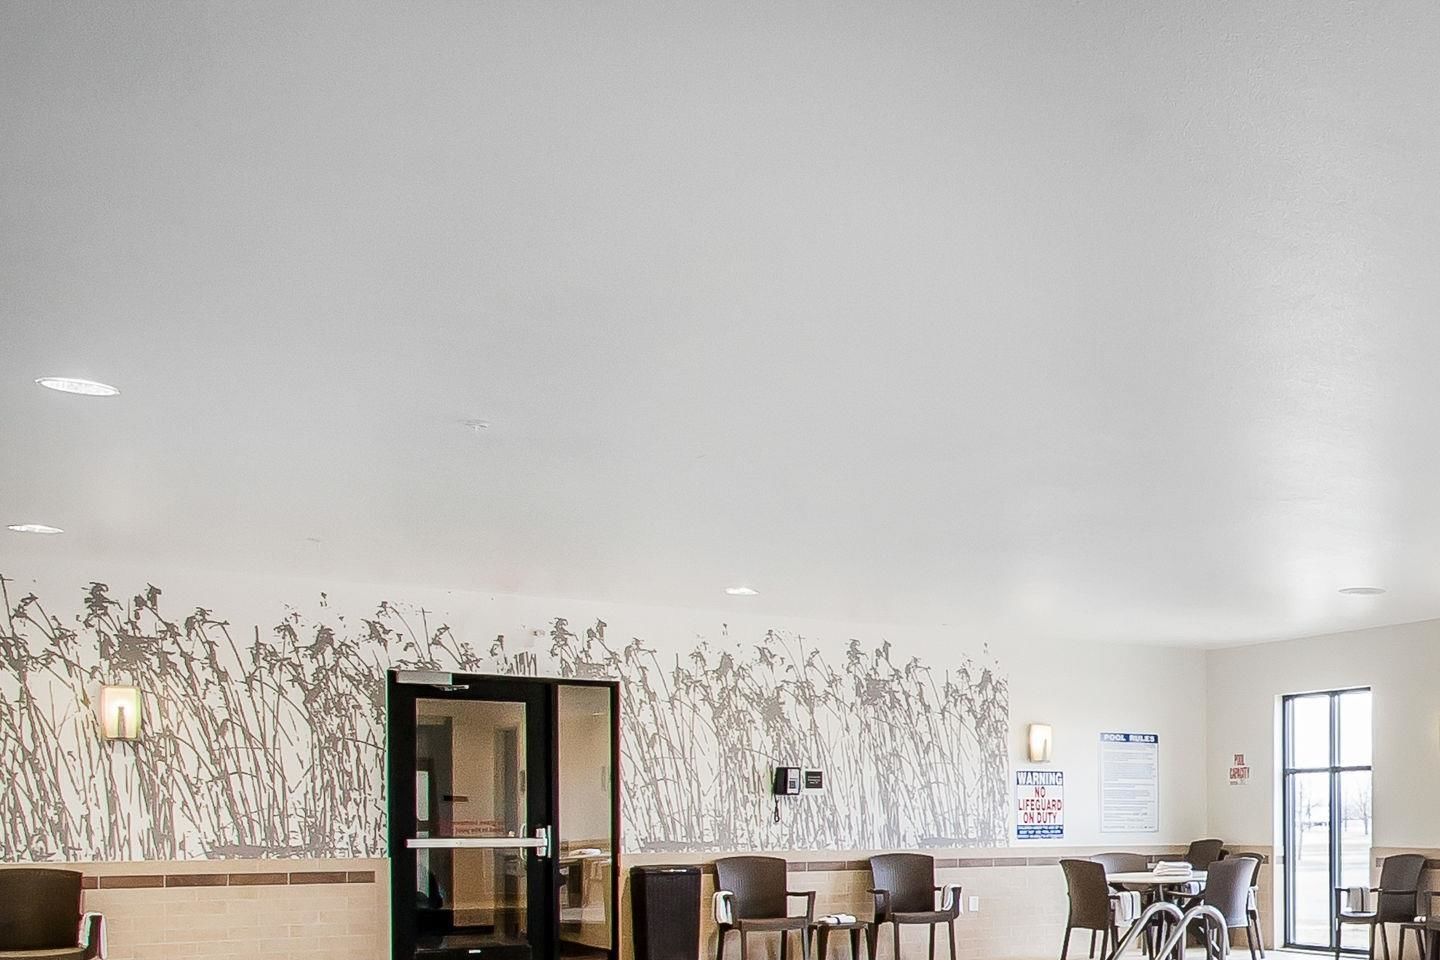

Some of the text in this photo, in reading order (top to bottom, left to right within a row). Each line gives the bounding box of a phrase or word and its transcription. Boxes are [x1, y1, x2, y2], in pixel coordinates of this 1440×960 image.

[1017, 772, 1063, 785] WARNING
[1034, 786, 1046, 798] NO
[1018, 799, 1062, 811] LIFEGUARD
[1023, 812, 1057, 823] ON DUTY
